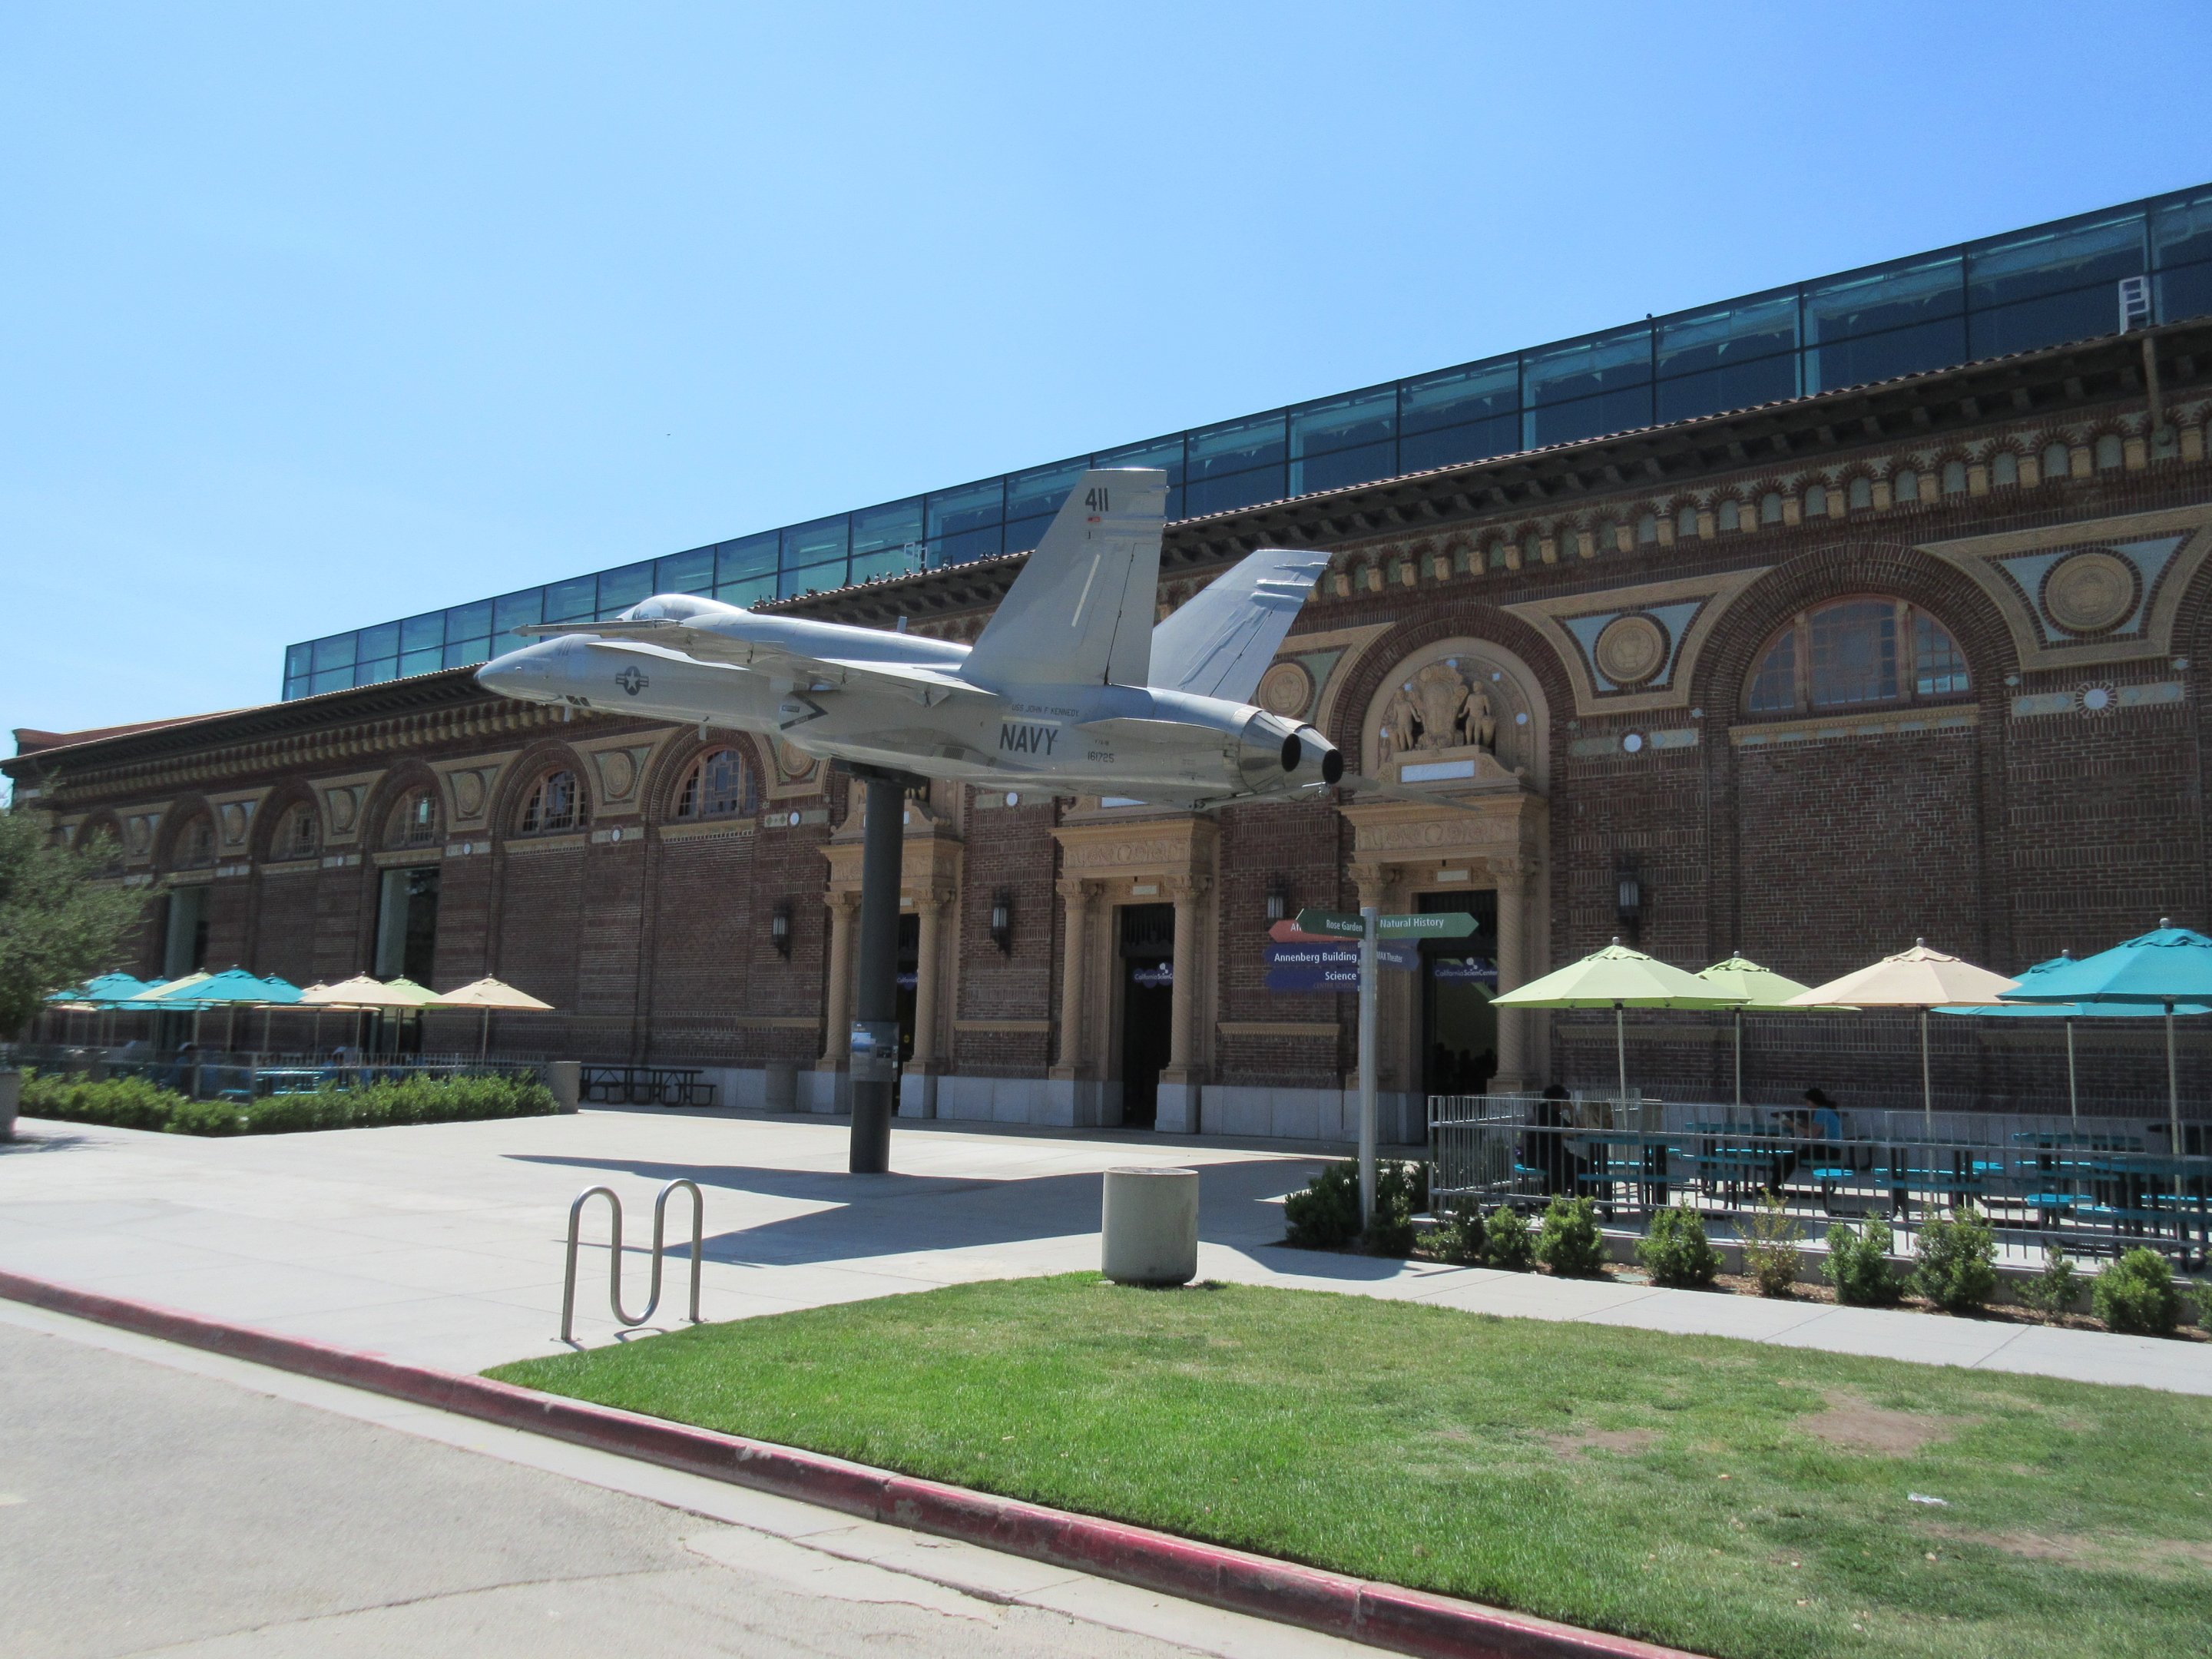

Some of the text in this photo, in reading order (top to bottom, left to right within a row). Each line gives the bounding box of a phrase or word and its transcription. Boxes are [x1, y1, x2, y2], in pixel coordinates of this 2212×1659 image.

[1085, 488, 1109, 512] 411
[1012, 704, 1024, 712] USS
[1025, 705, 1041, 714] JOHN
[1051, 708, 1079, 717] KENNEDY
[999, 724, 1058, 756] NAVY
[1088, 751, 1114, 763] 161725
[1326, 919, 1363, 932] Rose Garden
[1379, 918, 1444, 928] Natural History
[1274, 952, 1357, 963] Annenberg Building
[1376, 952, 1402, 962] MAX Theater
[1325, 972, 1356, 980] Science
